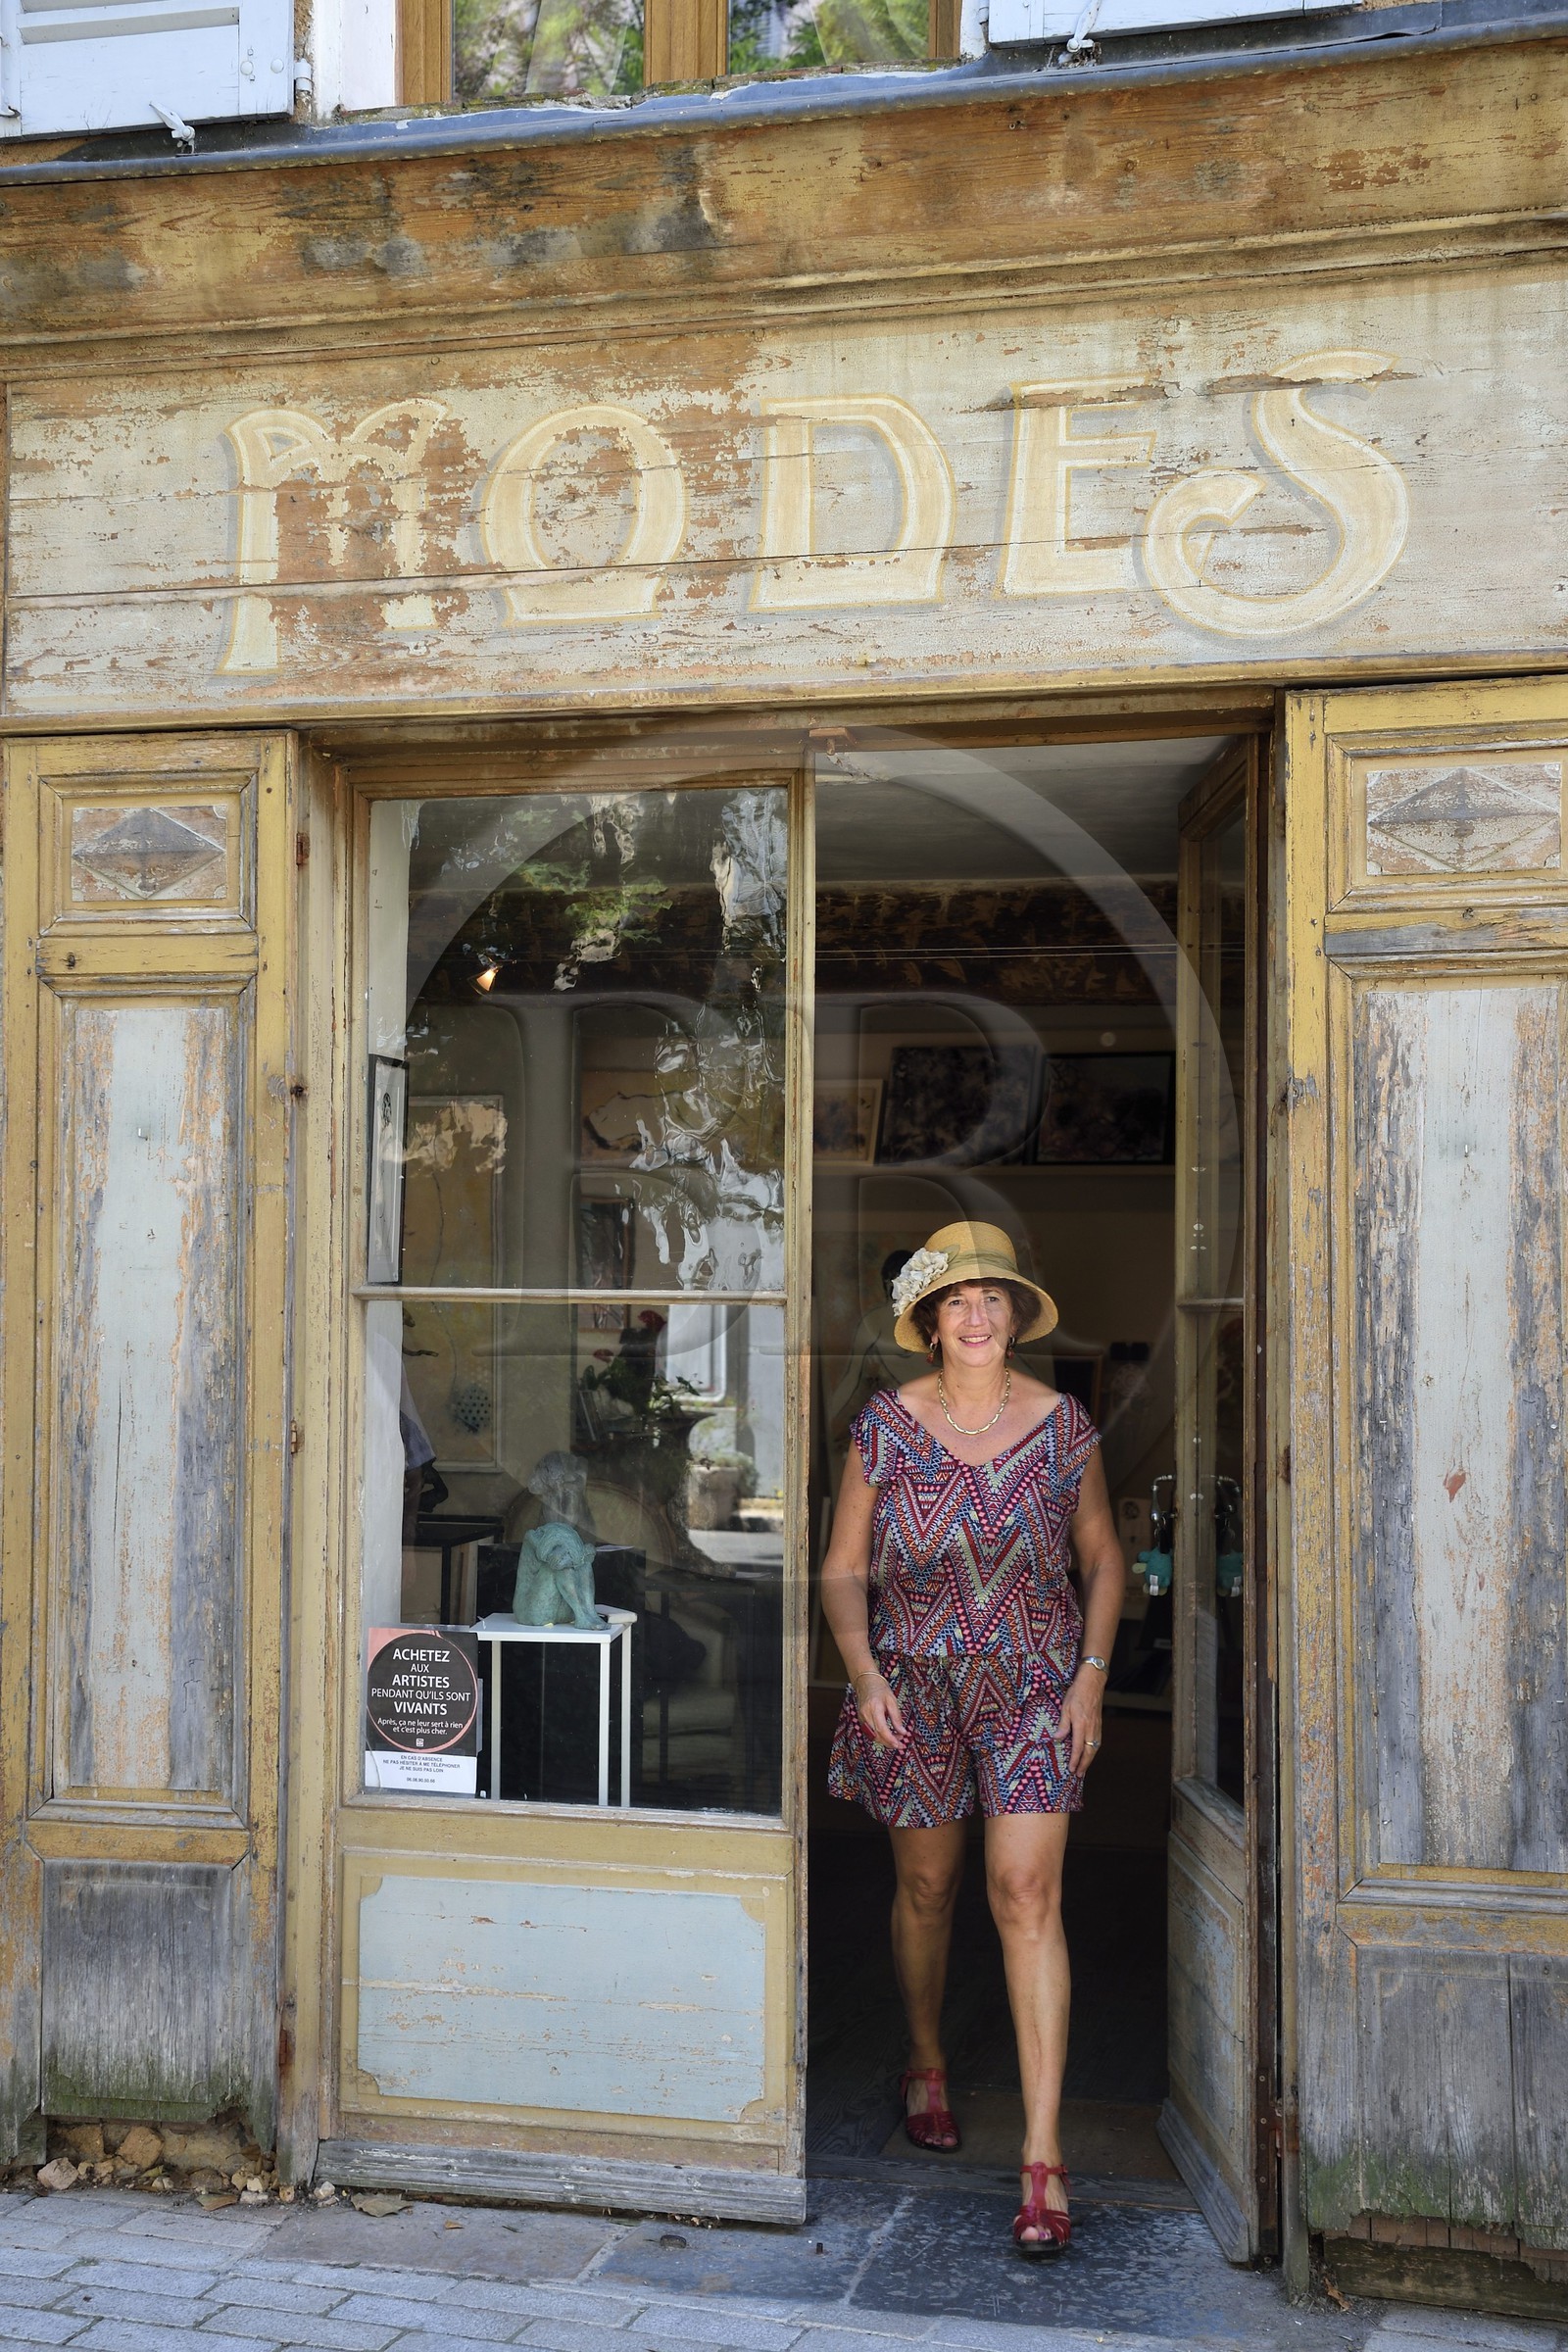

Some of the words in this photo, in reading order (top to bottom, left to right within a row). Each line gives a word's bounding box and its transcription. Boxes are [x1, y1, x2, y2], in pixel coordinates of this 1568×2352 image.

[215, 351, 1411, 676] MODES
[393, 1648, 450, 1662] ACHETEZ
[411, 1663, 429, 1673] AUX
[392, 1674, 450, 1688] ARTISTES
[371, 1688, 414, 1698] PENDANT
[416, 1690, 444, 1700] QU'ILS
[446, 1691, 470, 1702] SONT
[394, 1701, 447, 1715] VIVANTS
[377, 1717, 398, 1726] Après,
[416, 1718, 429, 1727] leur
[430, 1720, 444, 1729] sert
[450, 1720, 464, 1729] rien
[401, 1725, 416, 1734] c'est
[416, 1726, 430, 1735] plus
